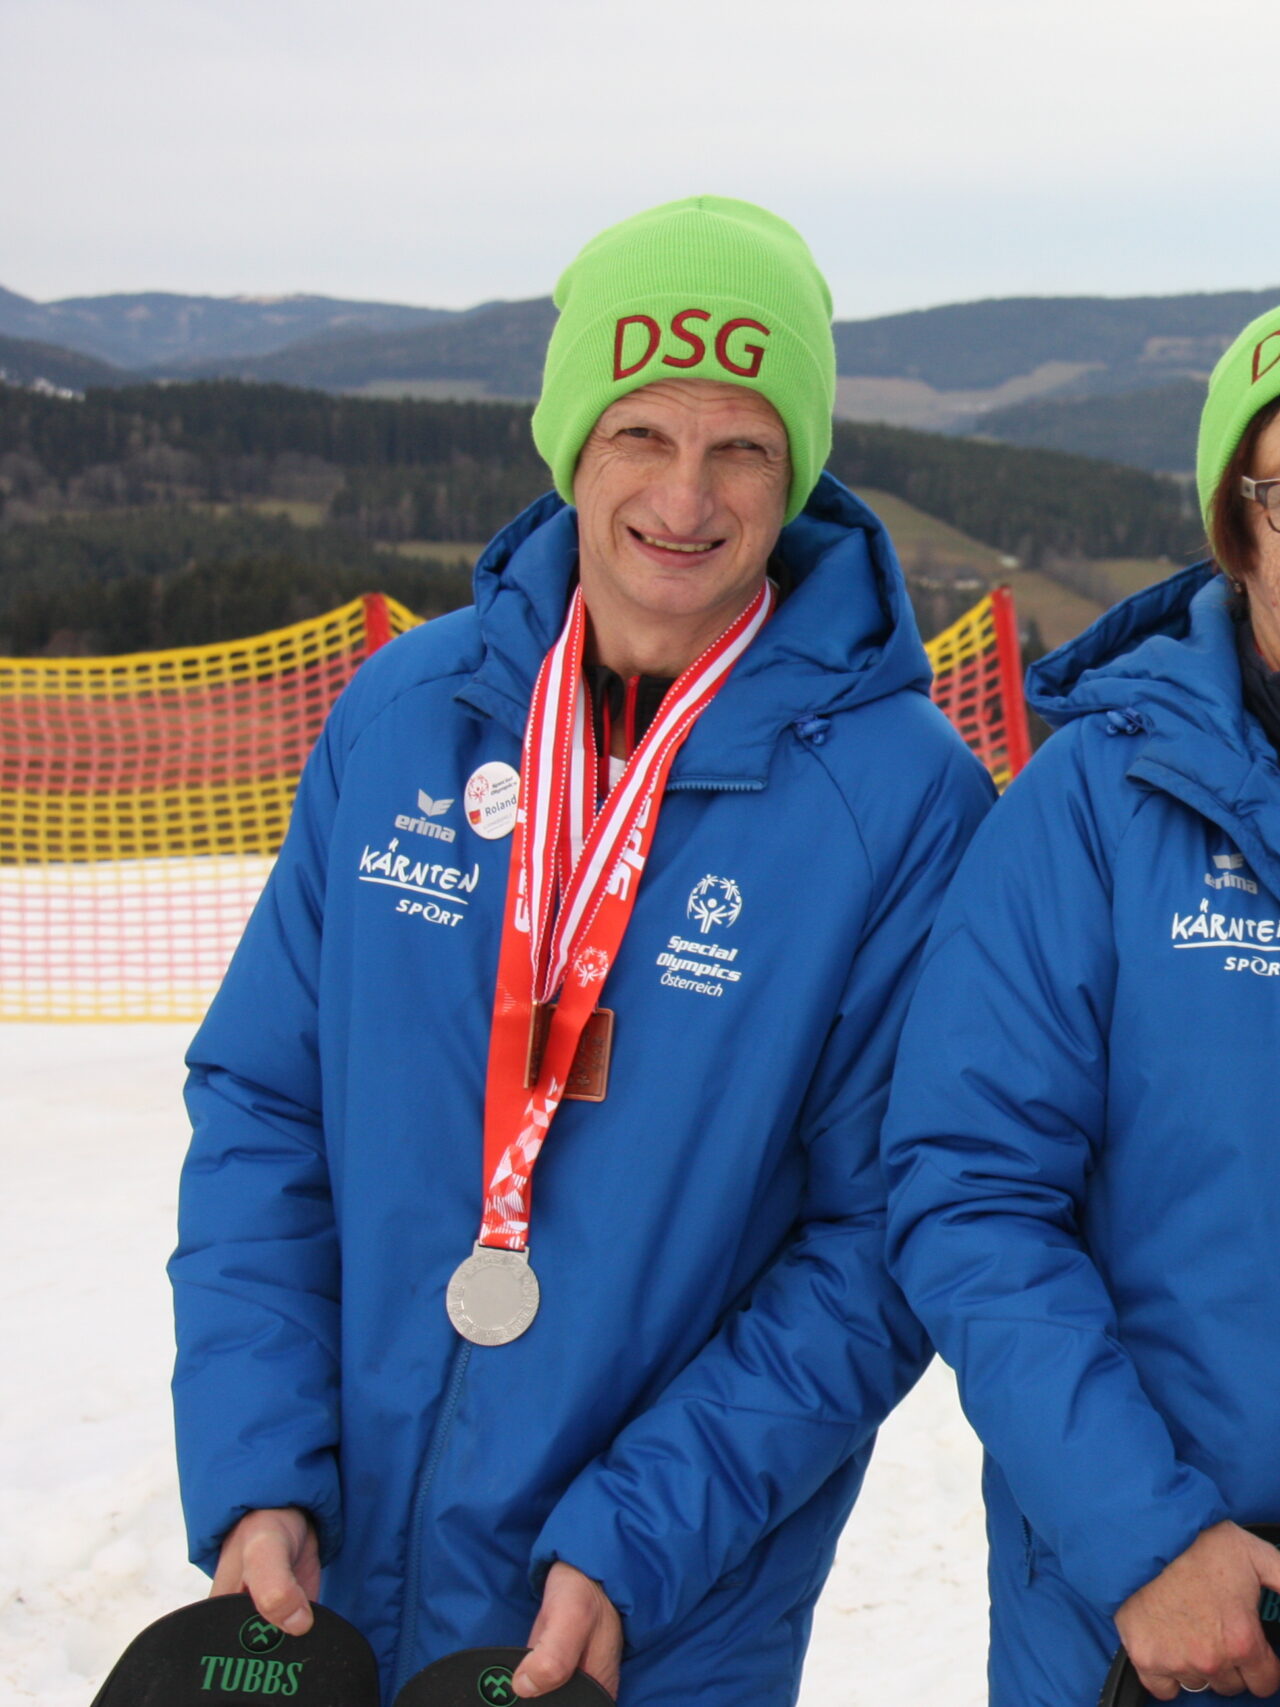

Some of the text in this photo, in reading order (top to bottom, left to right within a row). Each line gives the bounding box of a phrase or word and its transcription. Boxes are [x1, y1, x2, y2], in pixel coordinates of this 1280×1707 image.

[613, 308, 771, 381] DSG
[484, 794, 517, 816] Roland
[394, 814, 456, 843] erima
[359, 837, 479, 893] KÄRNTEN
[1204, 871, 1258, 895] erima
[395, 899, 464, 927] SPORT
[667, 935, 738, 962] Special
[656, 952, 742, 982] Olympics
[660, 970, 724, 997] Österreich
[200, 1655, 303, 1697] TUBBS
